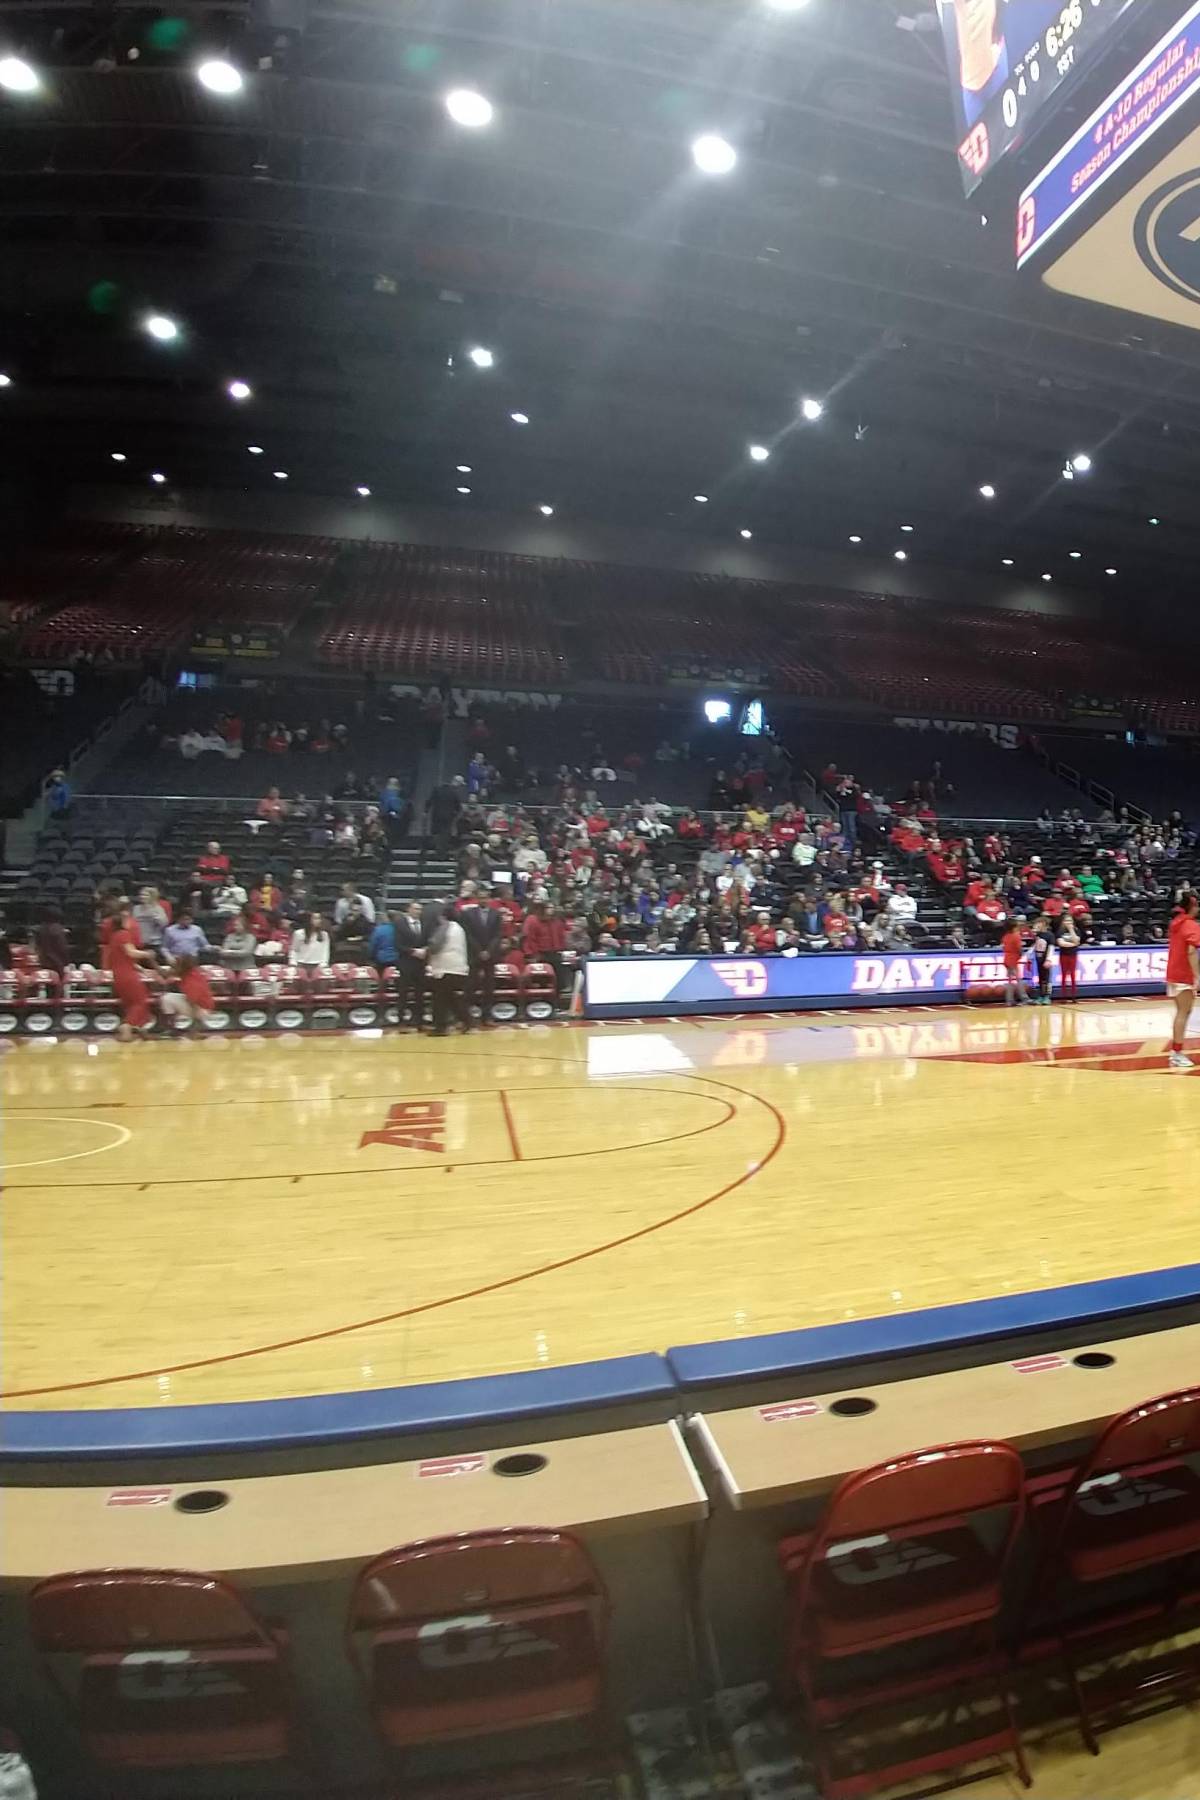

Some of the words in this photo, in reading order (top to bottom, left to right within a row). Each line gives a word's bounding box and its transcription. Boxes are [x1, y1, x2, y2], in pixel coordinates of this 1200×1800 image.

[1003, 89, 1017, 127] 0
[1104, 101, 1132, 136] A-10
[1133, 38, 1188, 101] Regular
[1070, 143, 1112, 193] Season
[852, 957, 1025, 990] DAYTO
[1030, 950, 1168, 988] YERS
